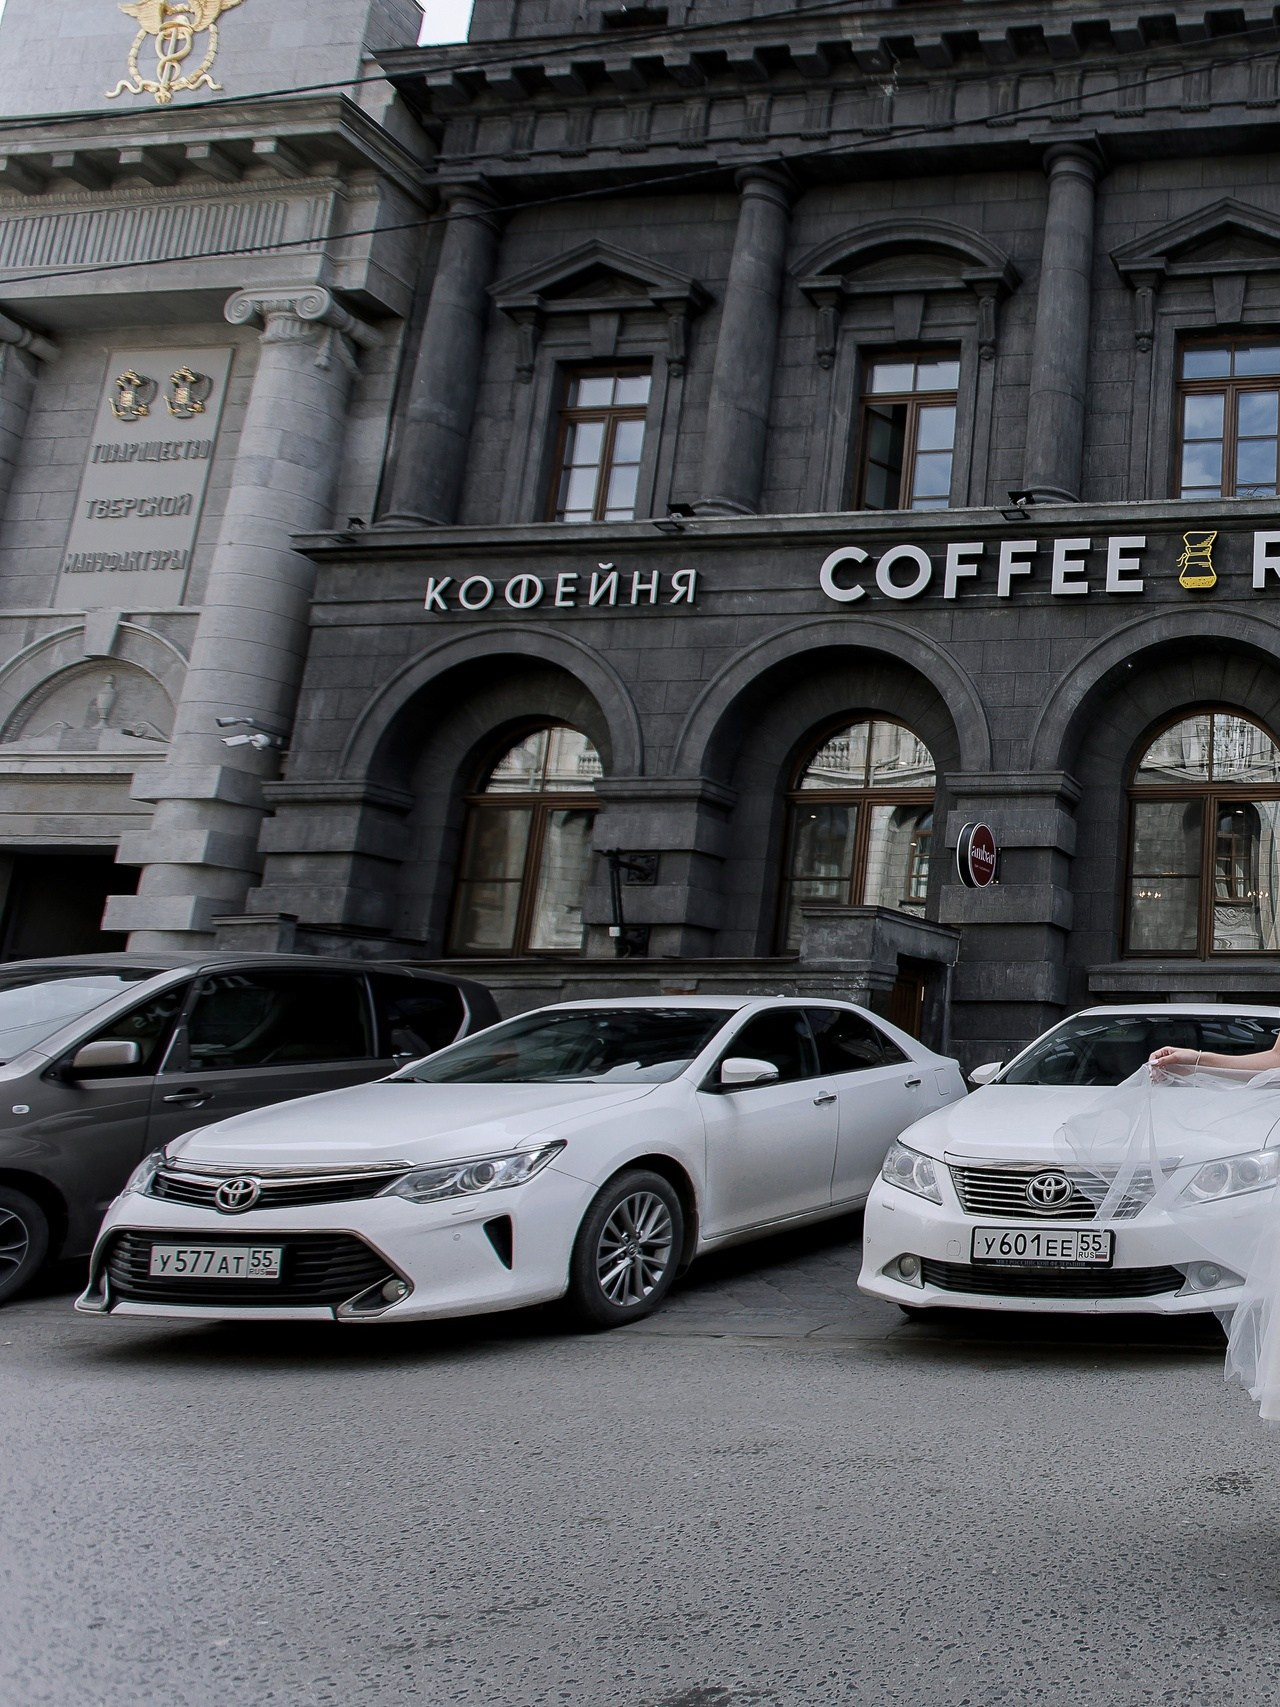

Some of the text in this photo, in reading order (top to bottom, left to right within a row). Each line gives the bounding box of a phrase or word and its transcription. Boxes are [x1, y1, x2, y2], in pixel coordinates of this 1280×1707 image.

[91, 439, 213, 464] ТОВАРИЩЕСТВО
[86, 493, 193, 519] ТВЕРСКОЙ
[63, 549, 189, 573] МАНУФАКТУРЫ
[819, 535, 1147, 603] COFFEE
[423, 563, 698, 611] КОФЕЙНЯ
[971, 844, 995, 865] ambar
[1079, 1234, 1102, 1251] 55
[250, 1250, 273, 1268] 55
[1078, 1251, 1095, 1259] RUS
